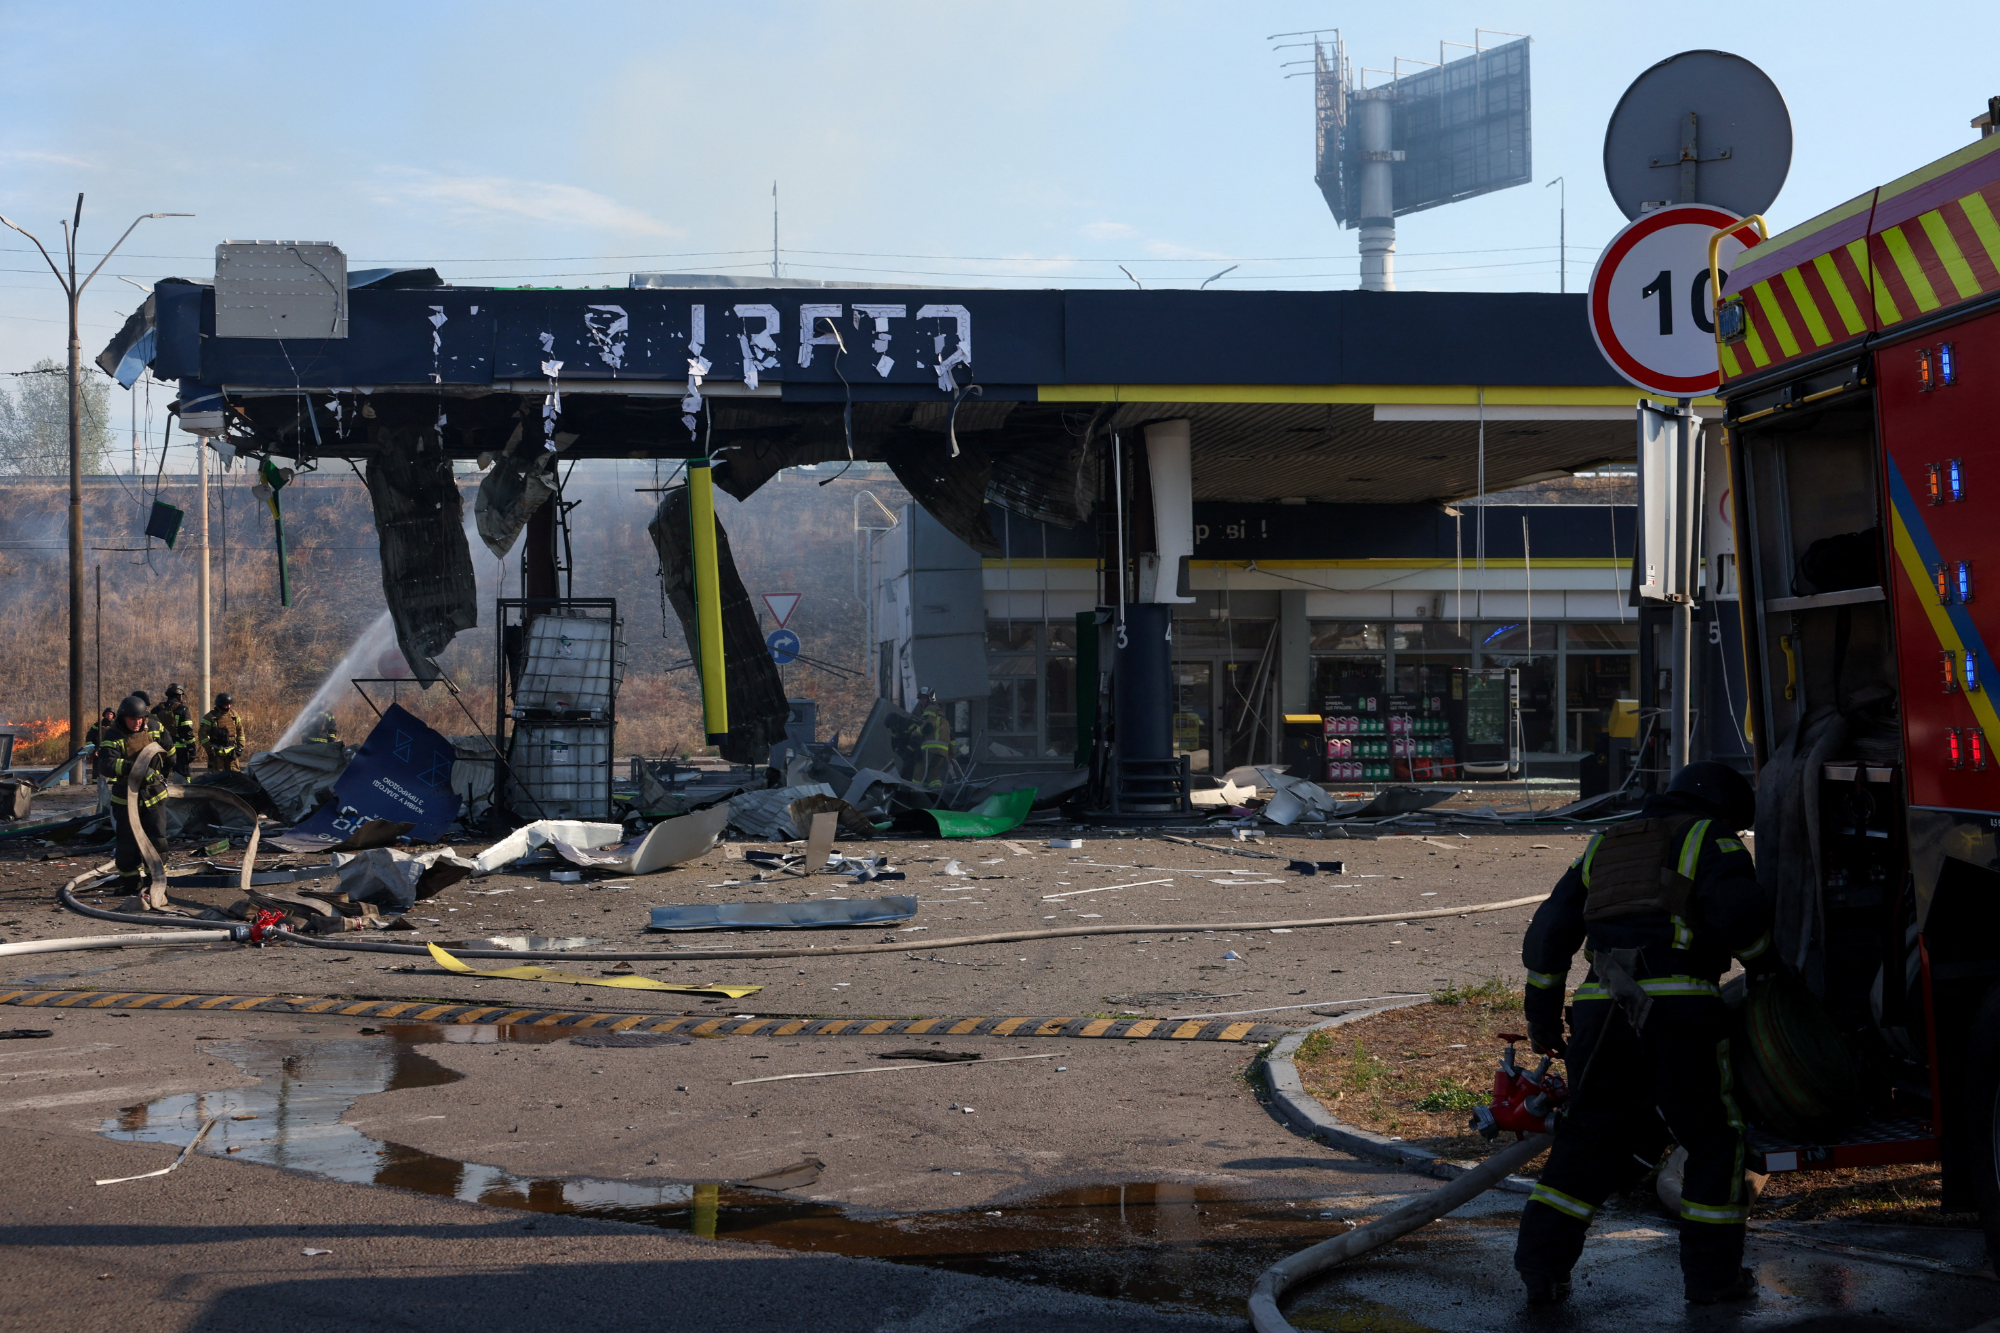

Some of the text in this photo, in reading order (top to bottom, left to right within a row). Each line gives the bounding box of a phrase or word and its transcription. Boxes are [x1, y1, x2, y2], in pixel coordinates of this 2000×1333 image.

[1116, 624, 1129, 650] 3
[1708, 621, 1721, 645] 5
[372, 779, 400, 799] ЗЛАГОДІ
[382, 776, 419, 803] ПРИРОДОЮ
[403, 800, 425, 815] ЖИВИ
